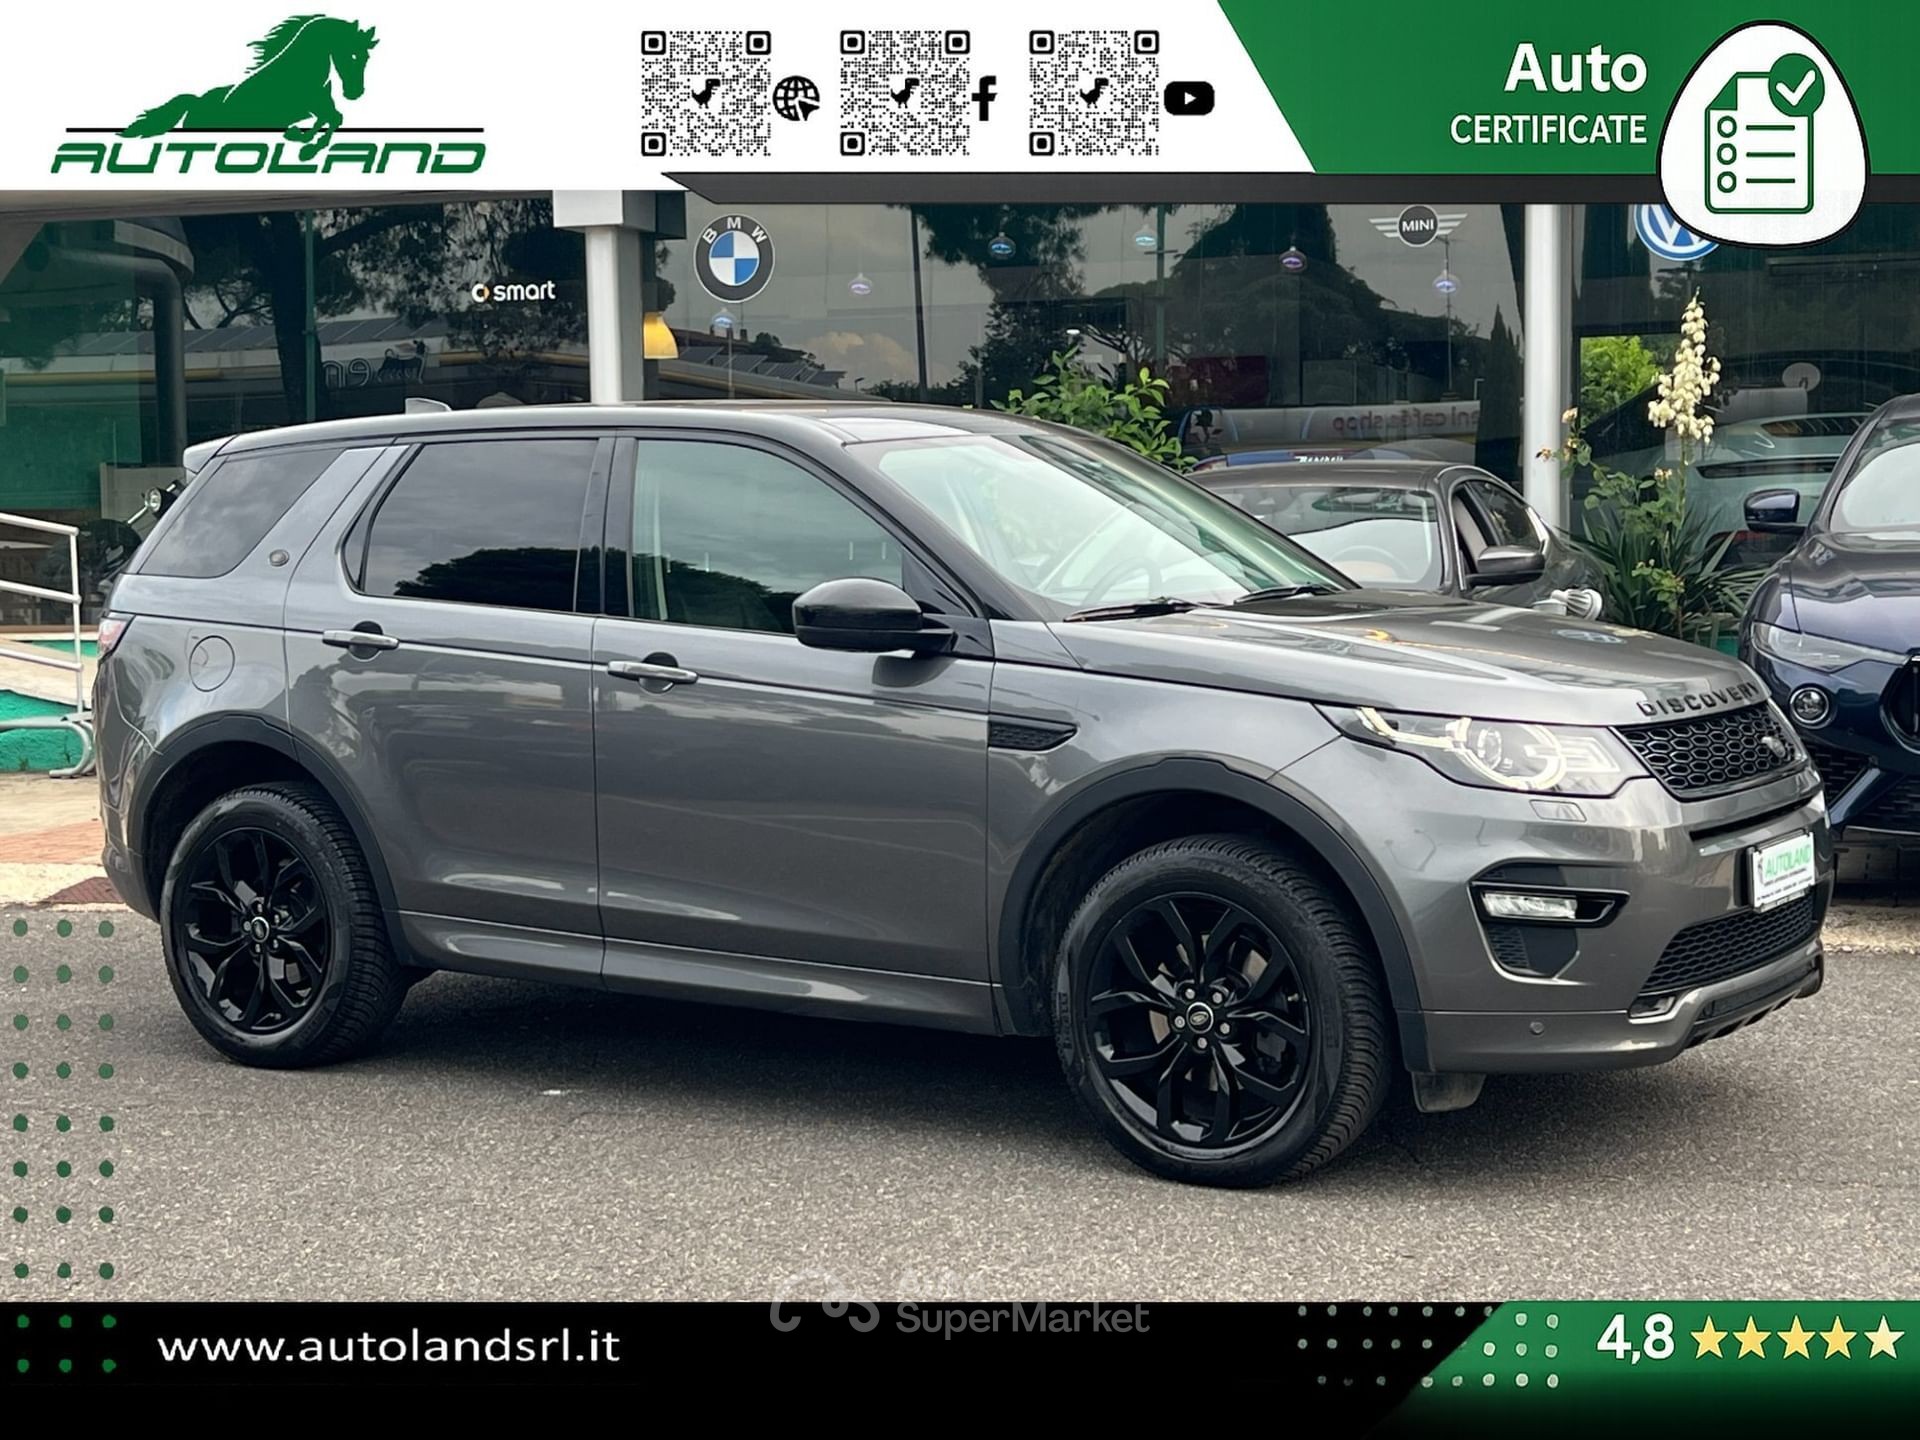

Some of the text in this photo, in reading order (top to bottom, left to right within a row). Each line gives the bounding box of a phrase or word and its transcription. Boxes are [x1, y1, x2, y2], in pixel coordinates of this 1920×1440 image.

[702, 215, 768, 245] BMW
[1402, 219, 1435, 232] MINI
[493, 280, 556, 302] smart
